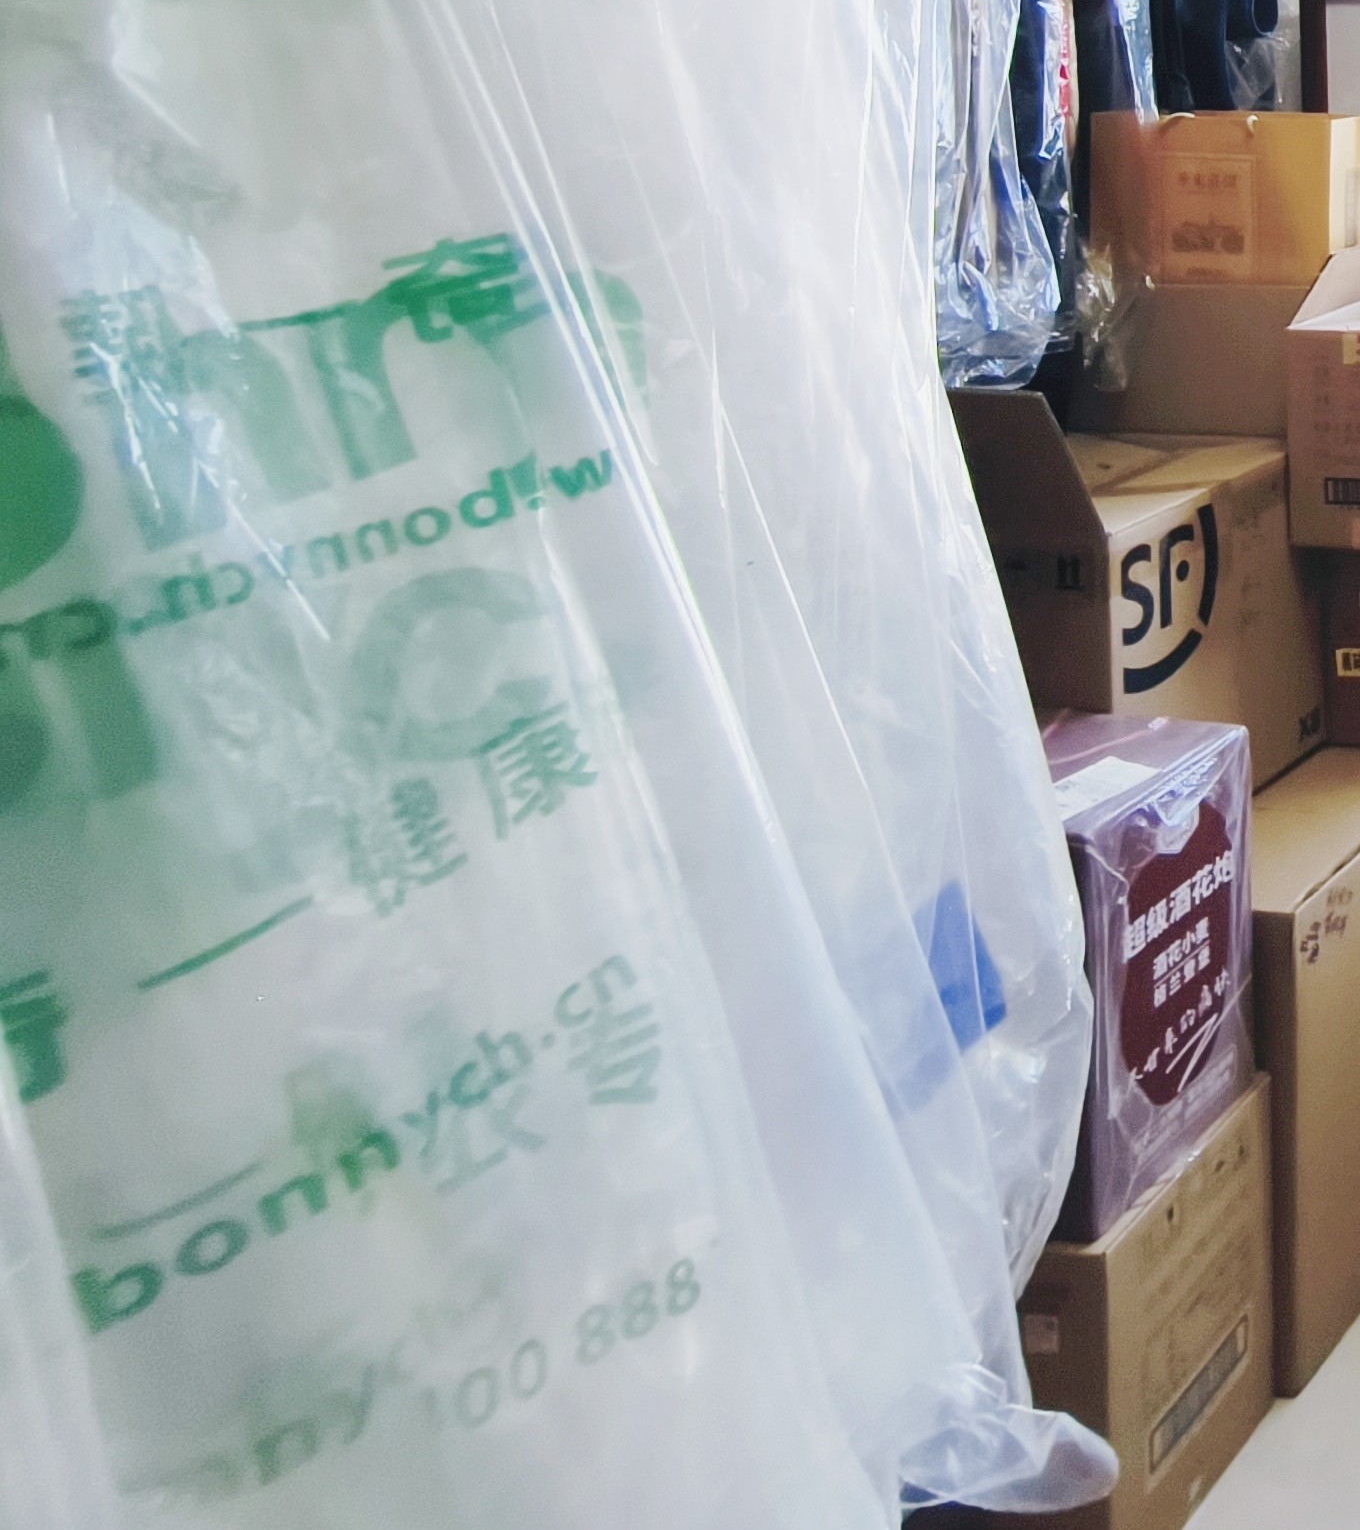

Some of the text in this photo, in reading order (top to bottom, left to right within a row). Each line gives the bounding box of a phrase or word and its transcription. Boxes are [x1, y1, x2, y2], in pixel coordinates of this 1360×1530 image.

[1122, 848, 1235, 963] 超级酒花炮
